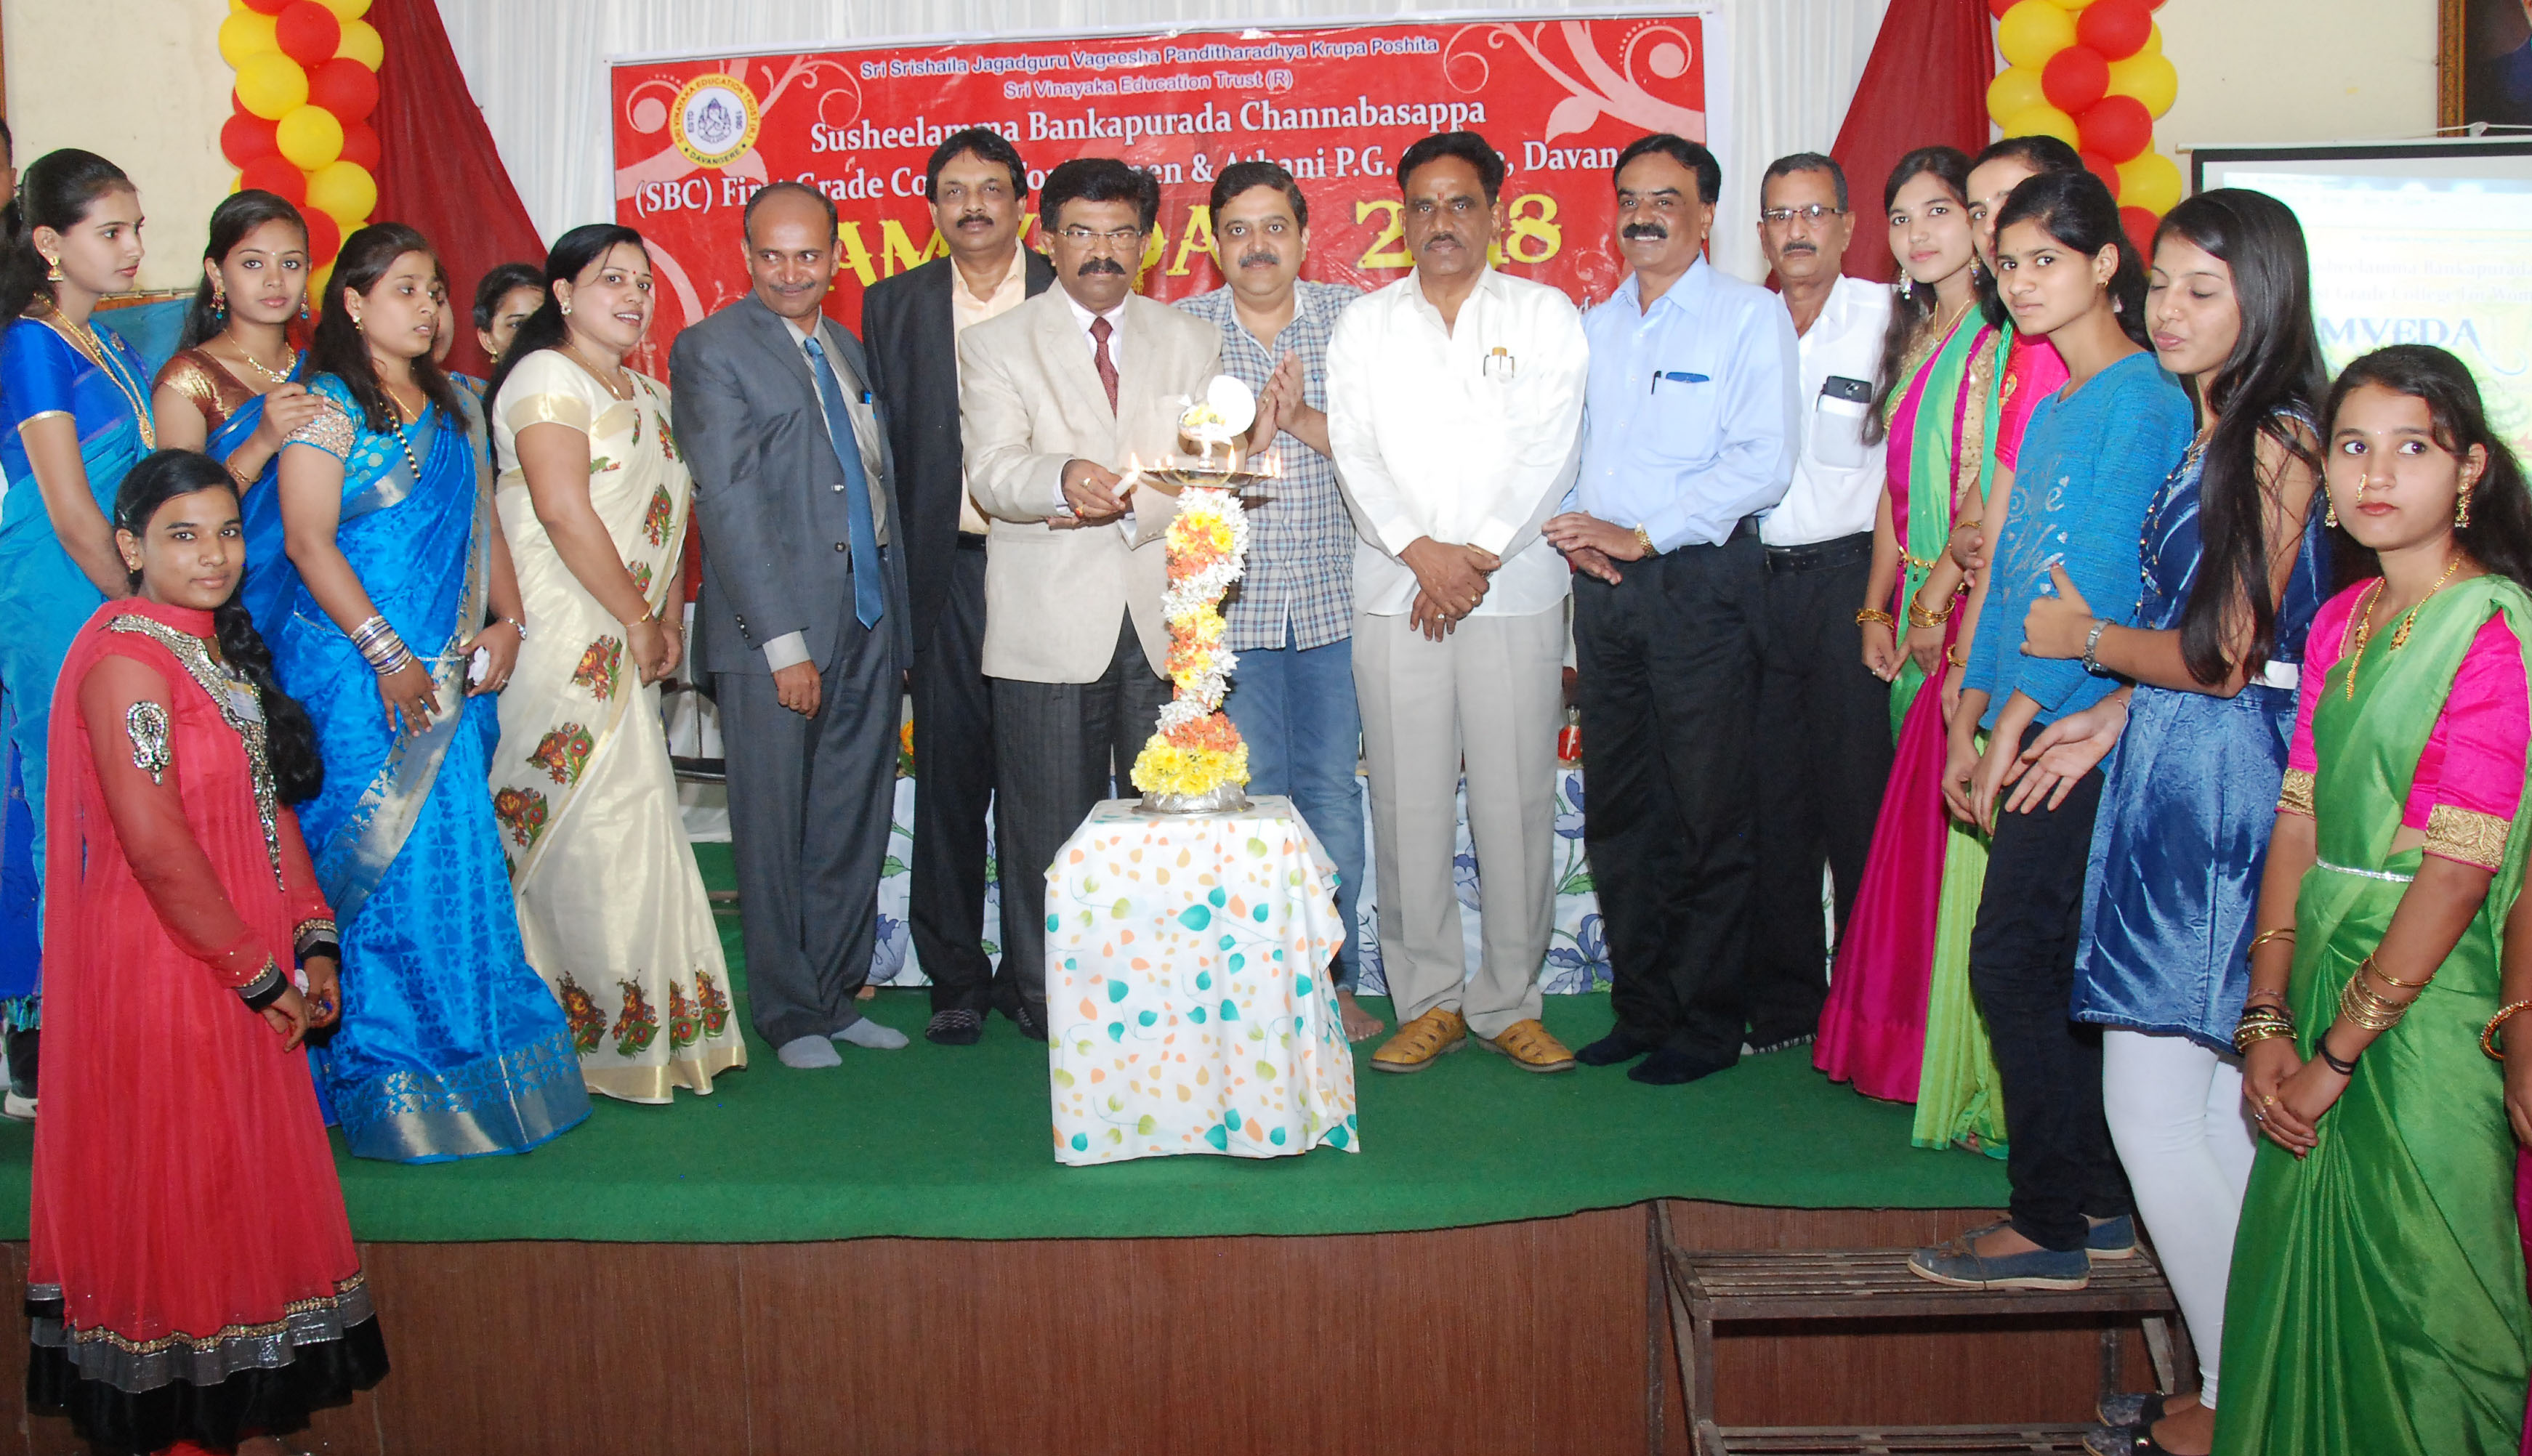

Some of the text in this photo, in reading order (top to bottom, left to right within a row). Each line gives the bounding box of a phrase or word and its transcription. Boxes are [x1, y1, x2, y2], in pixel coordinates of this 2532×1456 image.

[861, 36, 1440, 78] Sri Srishaila Jagadguru Vageesha Panditharadhya Krupa Poshita
[673, 87, 696, 126] VINAYAKA
[696, 77, 745, 94] EDUCATION
[1004, 70, 1294, 100] Sri Vinayaka Education Trust (R)
[1028, 102, 1233, 145] Bankapurada
[1240, 96, 1486, 133] Channabasappa
[635, 177, 712, 217] (SBC)
[796, 167, 885, 201] rade
[1190, 153, 1215, 183] &
[1334, 145, 1394, 177] P.G.
[1523, 140, 1626, 171] Davan
[690, 147, 741, 164] DAVANGERE
[1355, 193, 1563, 270] 28
